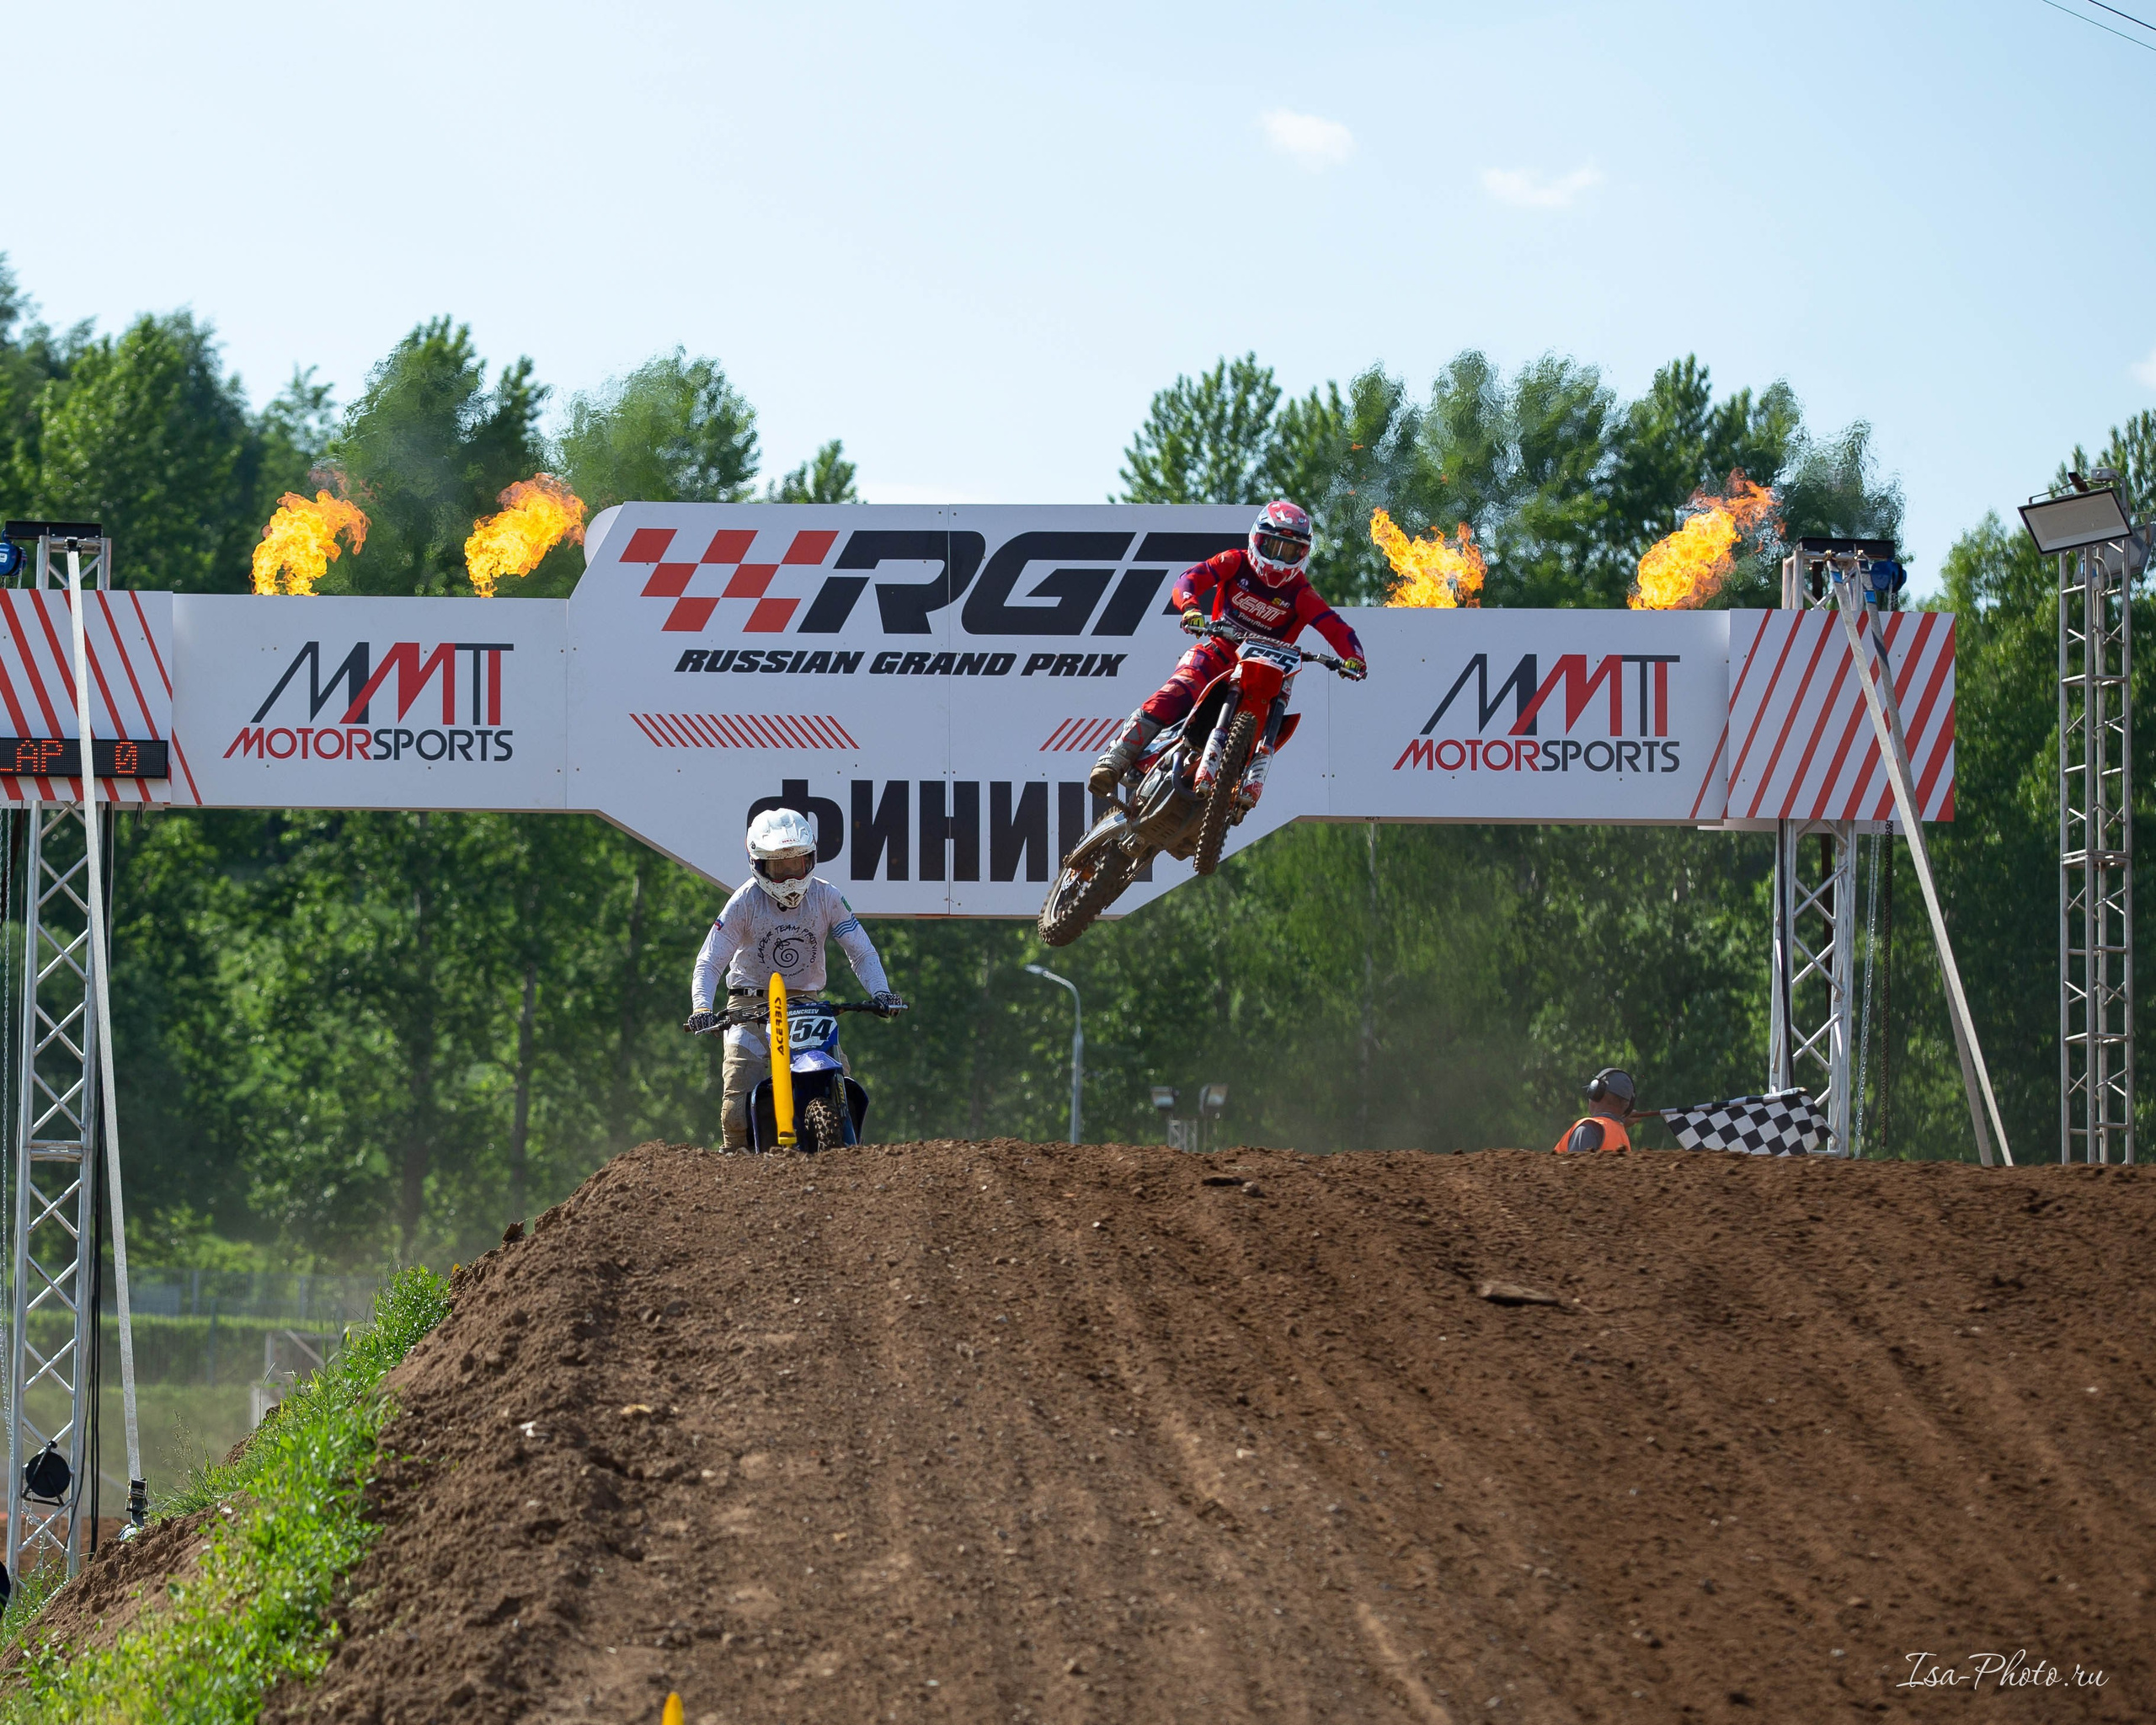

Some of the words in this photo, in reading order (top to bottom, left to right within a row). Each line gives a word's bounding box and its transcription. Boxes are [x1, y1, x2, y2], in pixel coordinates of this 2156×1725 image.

[1232, 591, 1287, 622] LEATT
[674, 649, 865, 674] RUSSIAN
[868, 651, 1017, 676] GRAND
[1020, 654, 1129, 677] PRIX
[115, 741, 138, 773] 0
[222, 727, 514, 761] MOTORSPORTS
[1392, 739, 1680, 772] MOTORSPORTS
[758, 931, 773, 964] LEADER
[775, 924, 800, 934] TEAM
